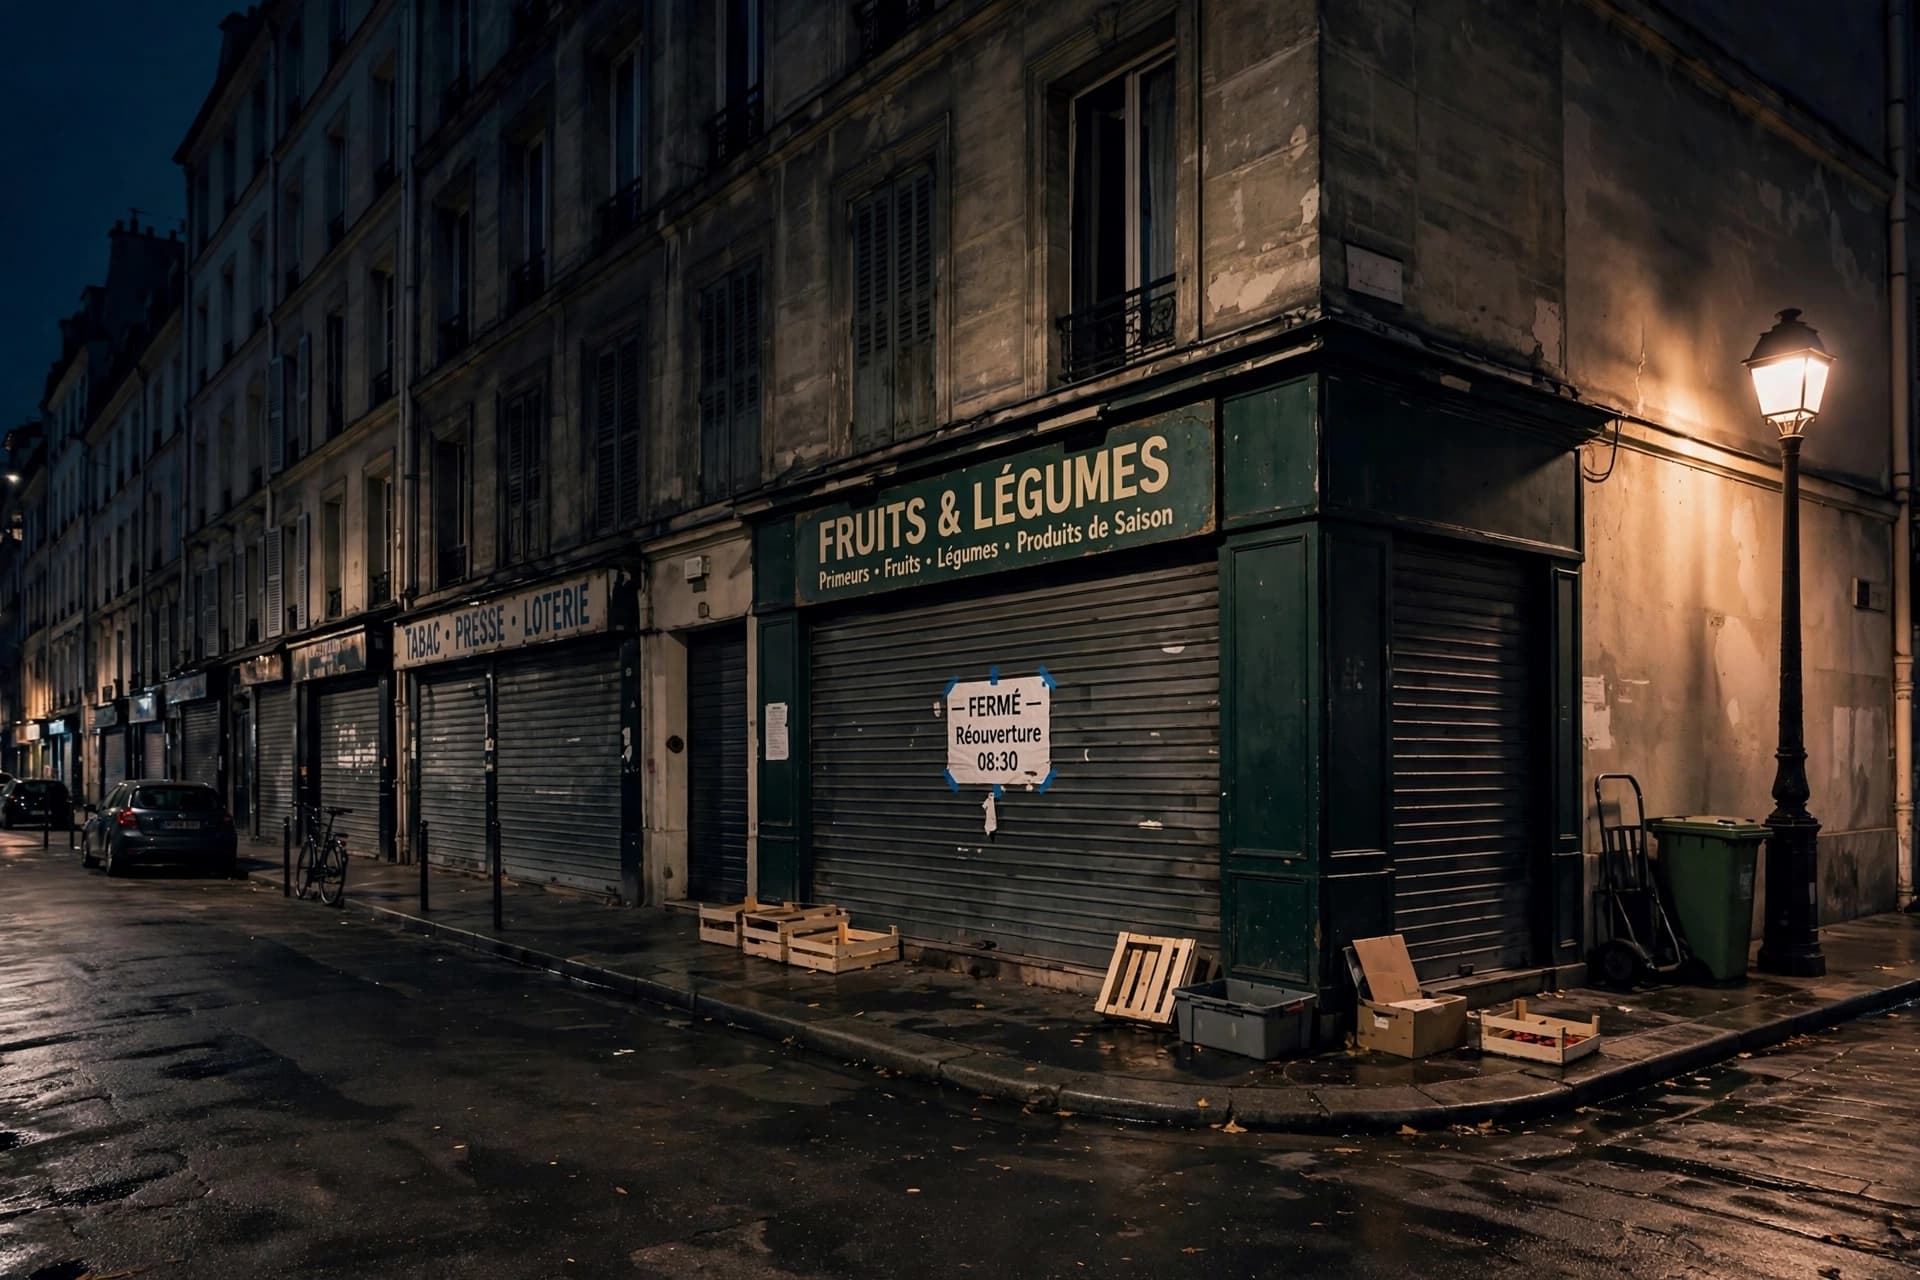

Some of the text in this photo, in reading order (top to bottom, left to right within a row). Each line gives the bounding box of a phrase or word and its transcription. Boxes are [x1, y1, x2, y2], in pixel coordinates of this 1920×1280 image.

[819, 435, 1169, 564] FRUITS & LÉGUMES
[818, 507, 1173, 591] Primeurs Fruits Légumes Produits de Saison
[405, 583, 589, 660] TABAC PRESSE LOTERIE
[969, 688, 1021, 717] FERMÉ
[956, 724, 1041, 745] Réouverture
[977, 751, 1018, 771] 08:30
